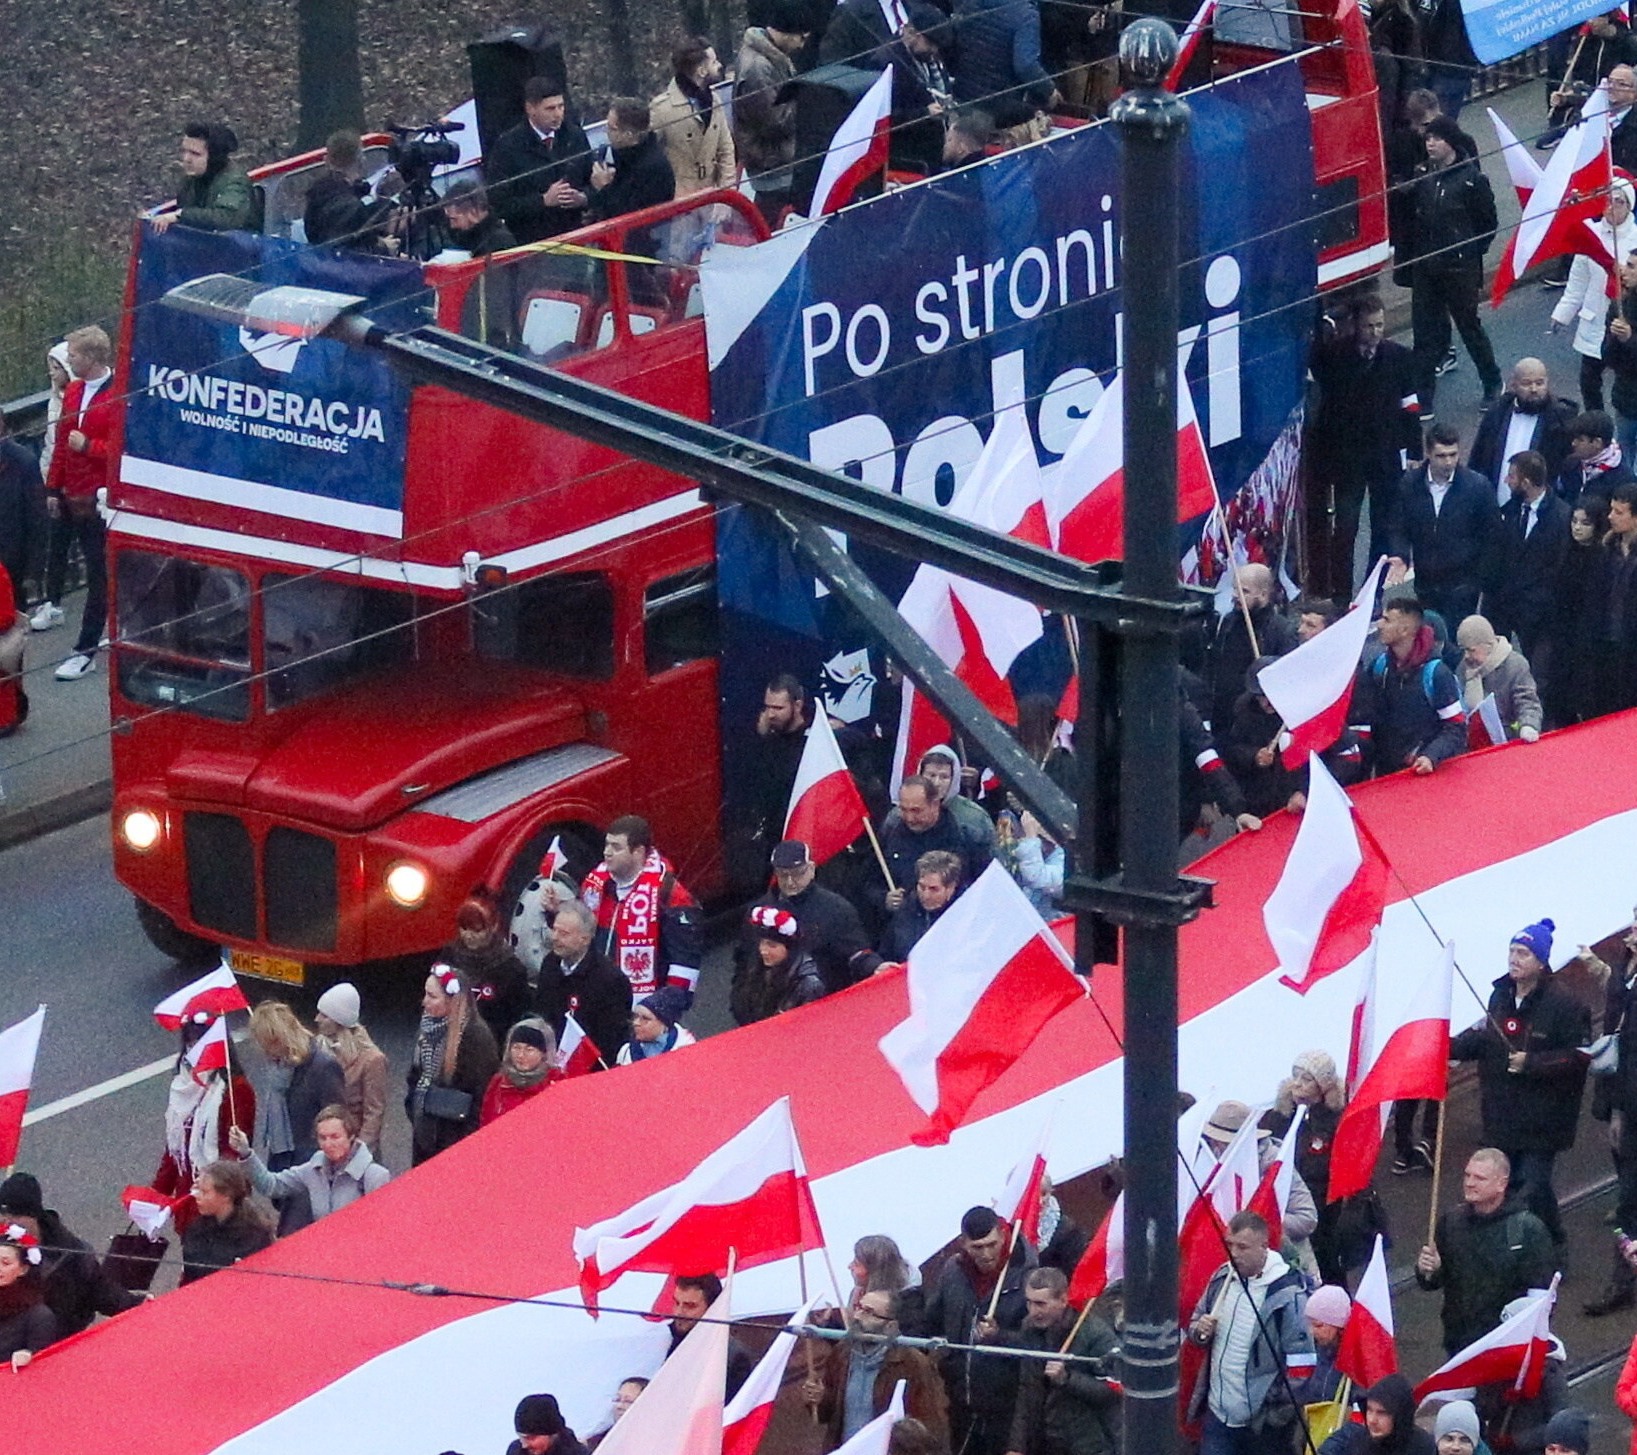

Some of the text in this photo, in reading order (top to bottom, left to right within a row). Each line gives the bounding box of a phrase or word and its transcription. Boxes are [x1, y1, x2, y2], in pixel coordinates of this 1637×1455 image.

[802, 194, 1124, 397] Po stroni
[148, 364, 385, 443] KONFEDERACJA
[180, 408, 349, 454] WOLNOŚĆ I NIEPODLEGŁOŚĆ
[809, 255, 1242, 598] Posi
